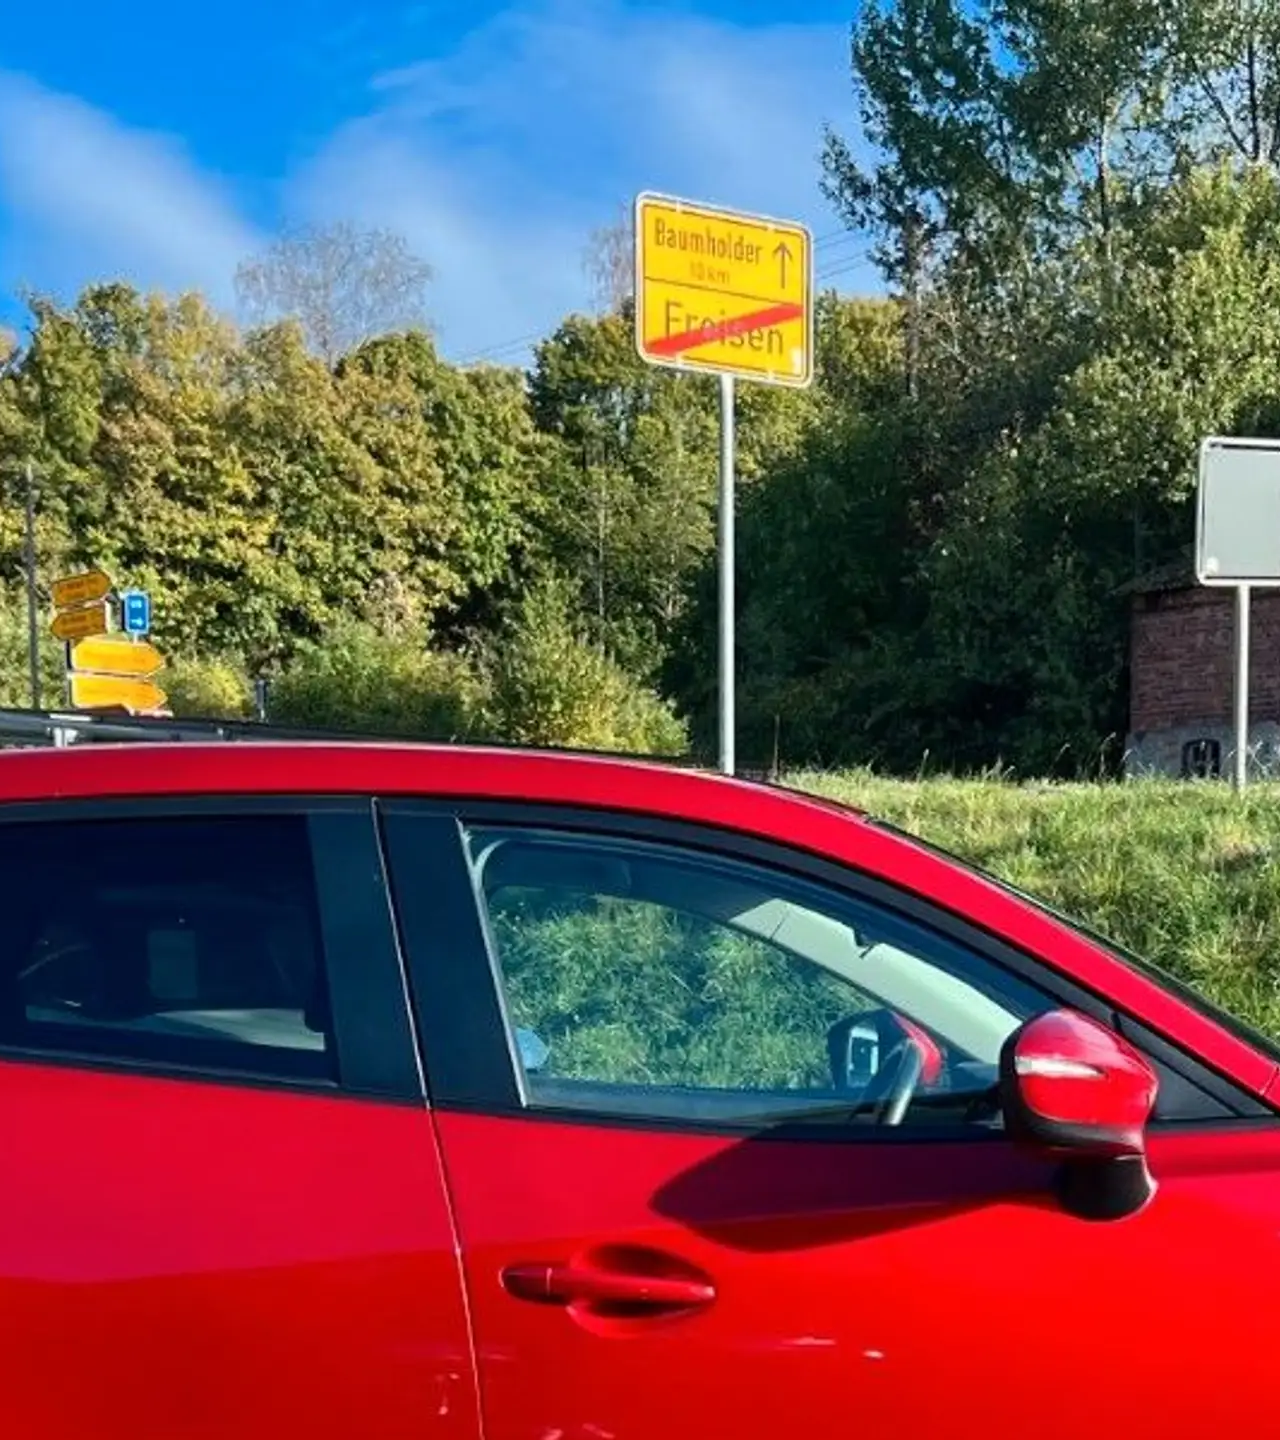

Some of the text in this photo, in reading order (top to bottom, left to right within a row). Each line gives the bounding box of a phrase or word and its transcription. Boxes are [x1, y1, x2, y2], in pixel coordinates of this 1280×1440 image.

[654, 217, 764, 265] Baumholder
[707, 265, 731, 285] km
[665, 299, 784, 355] Freisen
